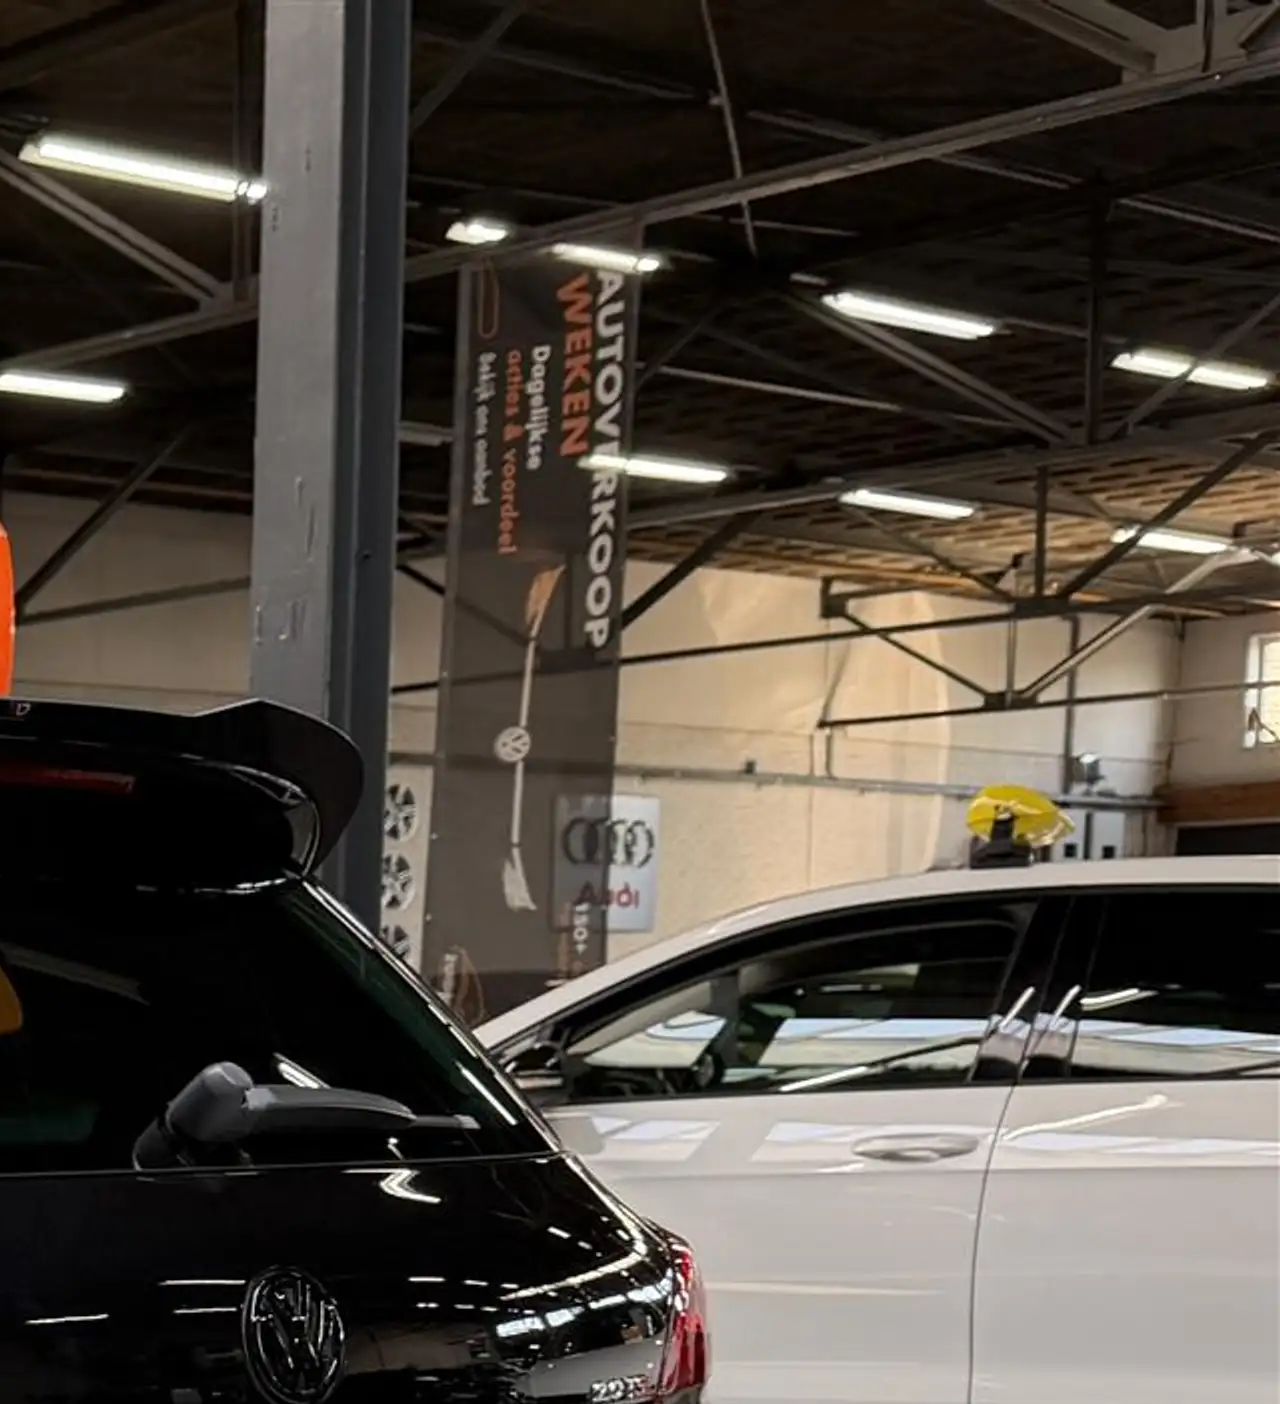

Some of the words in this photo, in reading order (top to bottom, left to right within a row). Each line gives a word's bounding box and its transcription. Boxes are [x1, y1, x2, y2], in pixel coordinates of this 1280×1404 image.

[505, 350, 524, 417] acties
[526, 344, 552, 471] Dagelijkse
[556, 272, 592, 457] WEKEN
[498, 448, 520, 555] voordeel
